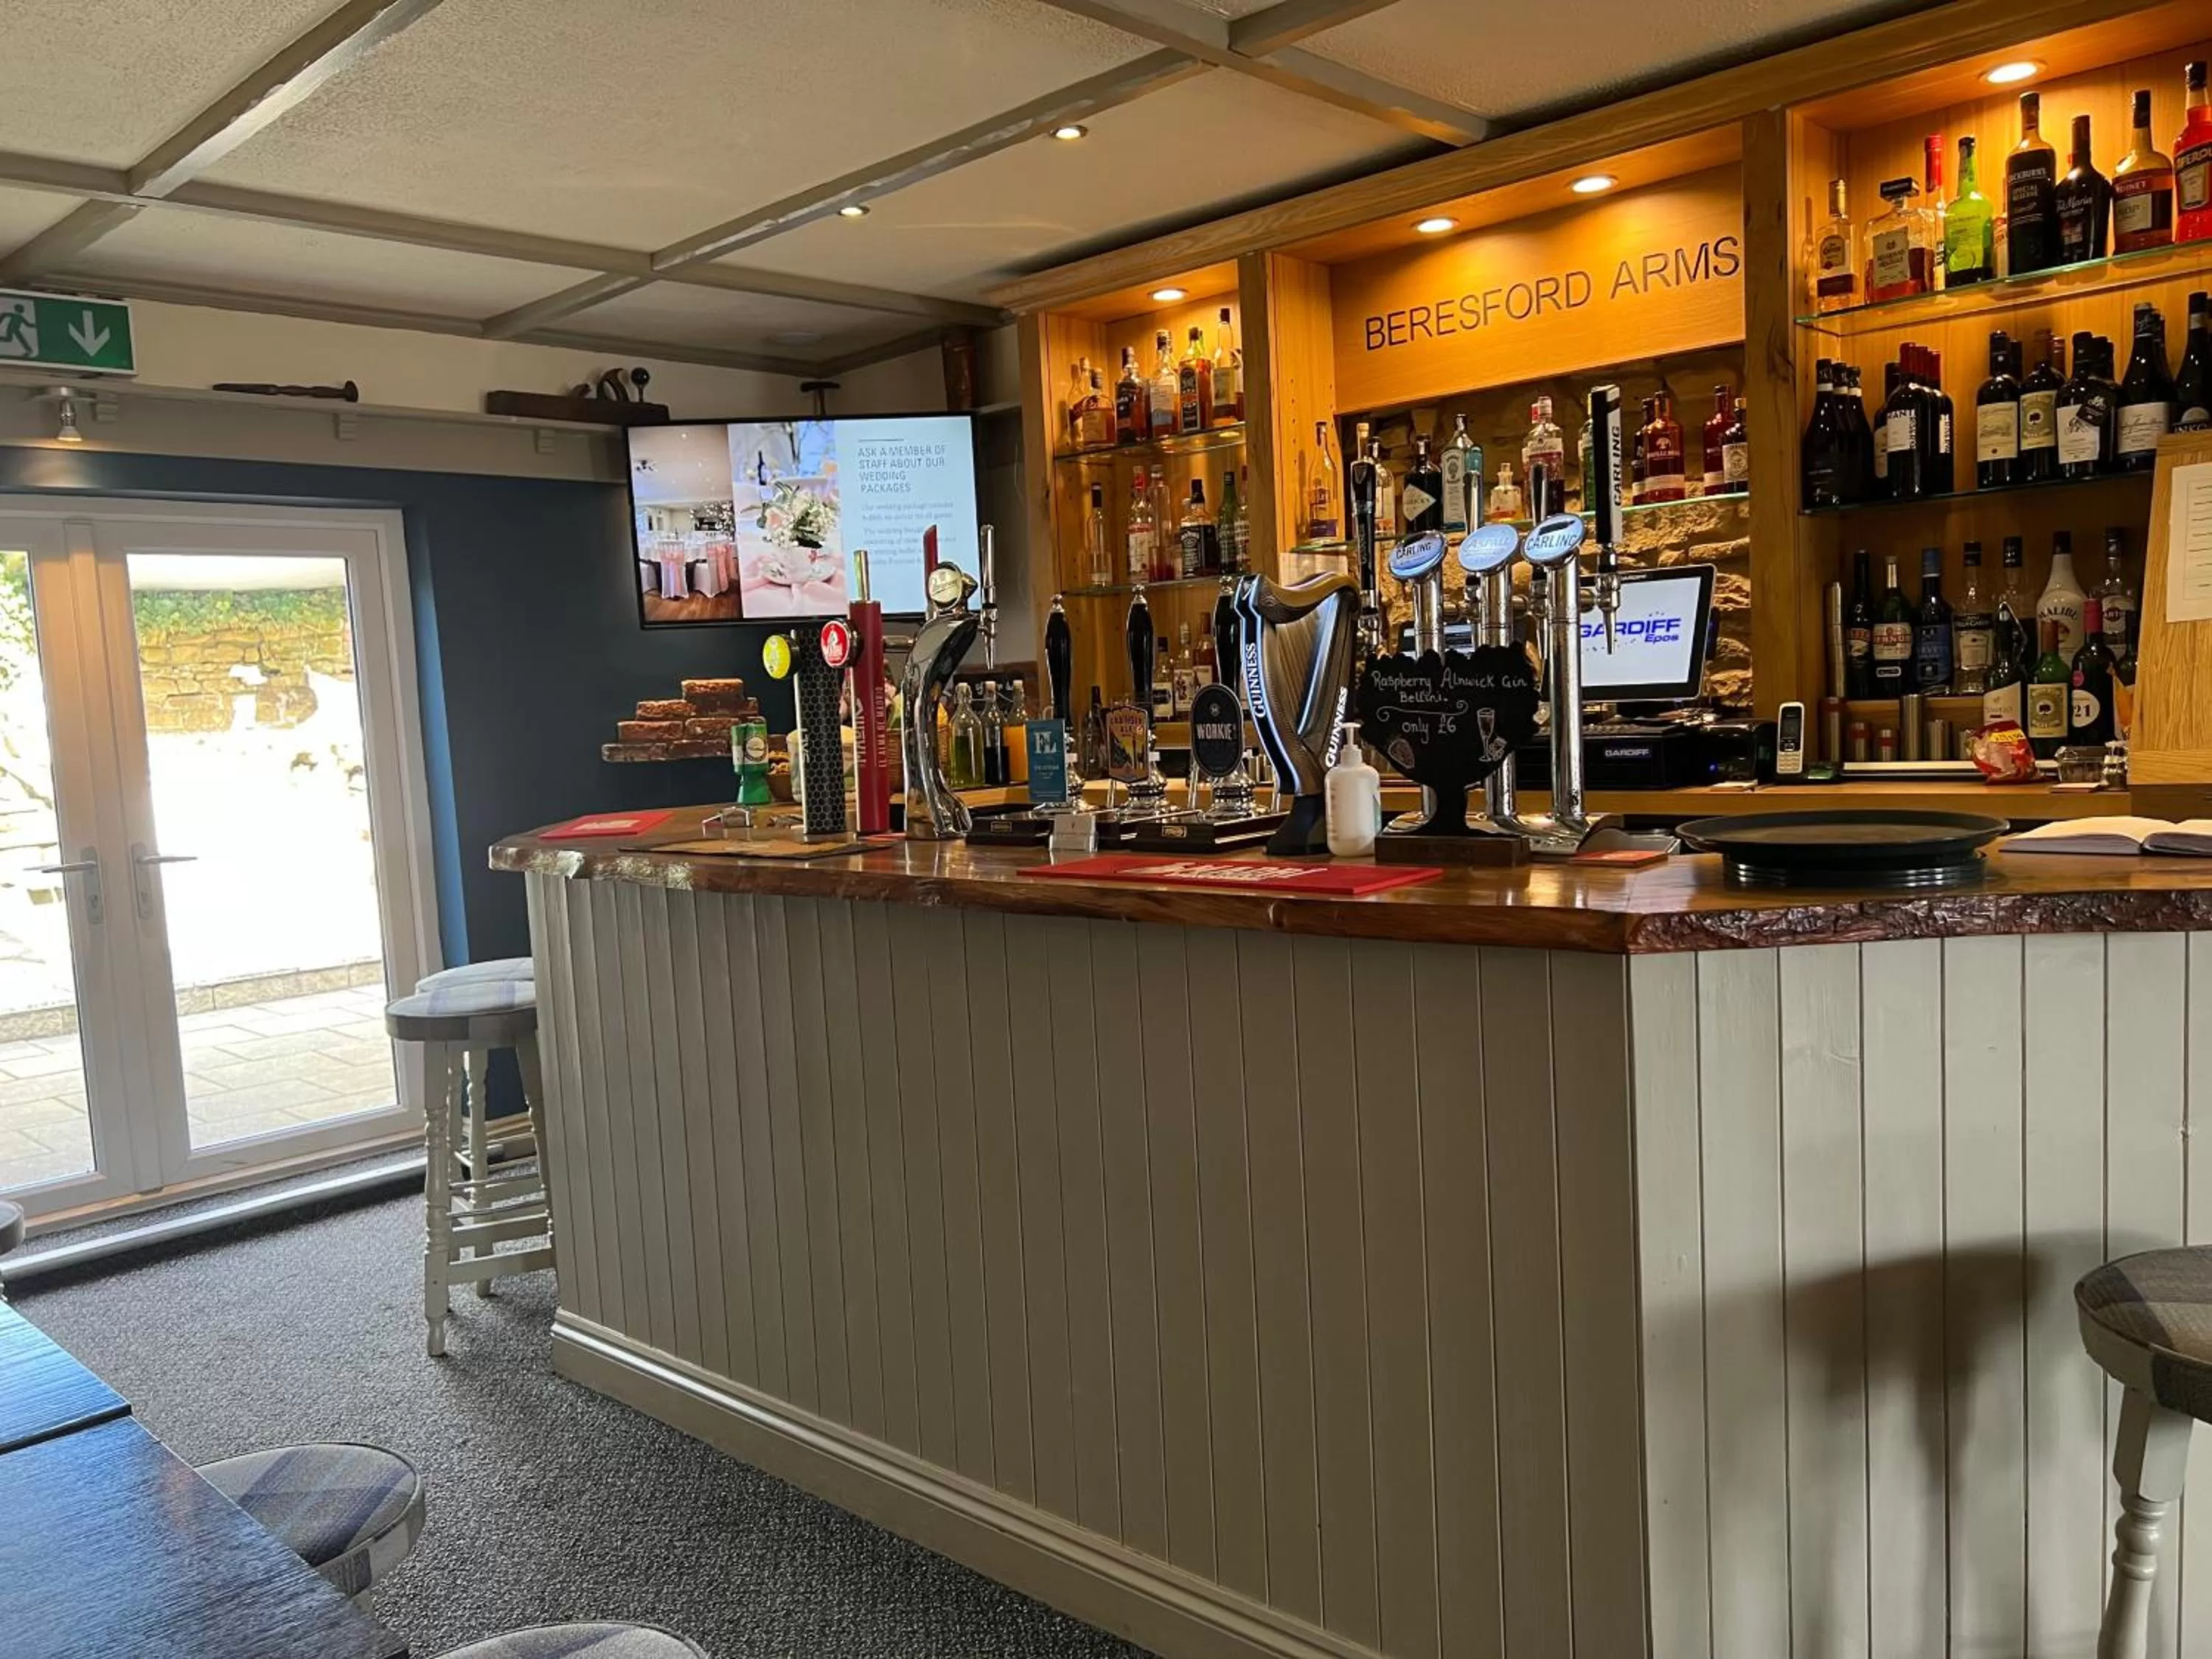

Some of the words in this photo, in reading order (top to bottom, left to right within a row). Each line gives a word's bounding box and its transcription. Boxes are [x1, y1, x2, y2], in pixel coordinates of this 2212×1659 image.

[1364, 271, 1592, 351] BERESFORD
[1610, 235, 1741, 299] ARMS
[858, 448, 877, 457] ASK
[880, 447, 887, 456] A
[889, 445, 931, 456] MEMBER
[859, 459, 888, 469] STAFF
[890, 458, 922, 468] ABOUT
[925, 457, 945, 467] OUR
[1611, 425, 1621, 507] CARLING
[860, 471, 906, 481] WEDDING
[861, 483, 911, 493] PACKAGES
[1396, 542, 1432, 560] CARLING
[1526, 534, 1578, 552] CARLING
[1644, 634, 1679, 644] Epos
[1245, 642, 1267, 718] GUINNESS
[1371, 670, 1432, 696] Raspberry
[1502, 675, 1528, 687] Gin
[2074, 704, 2091, 717] 21
[1325, 686, 1349, 768] GUINNESS
[1402, 717, 1430, 744] only
[1438, 713, 1456, 734] £6
